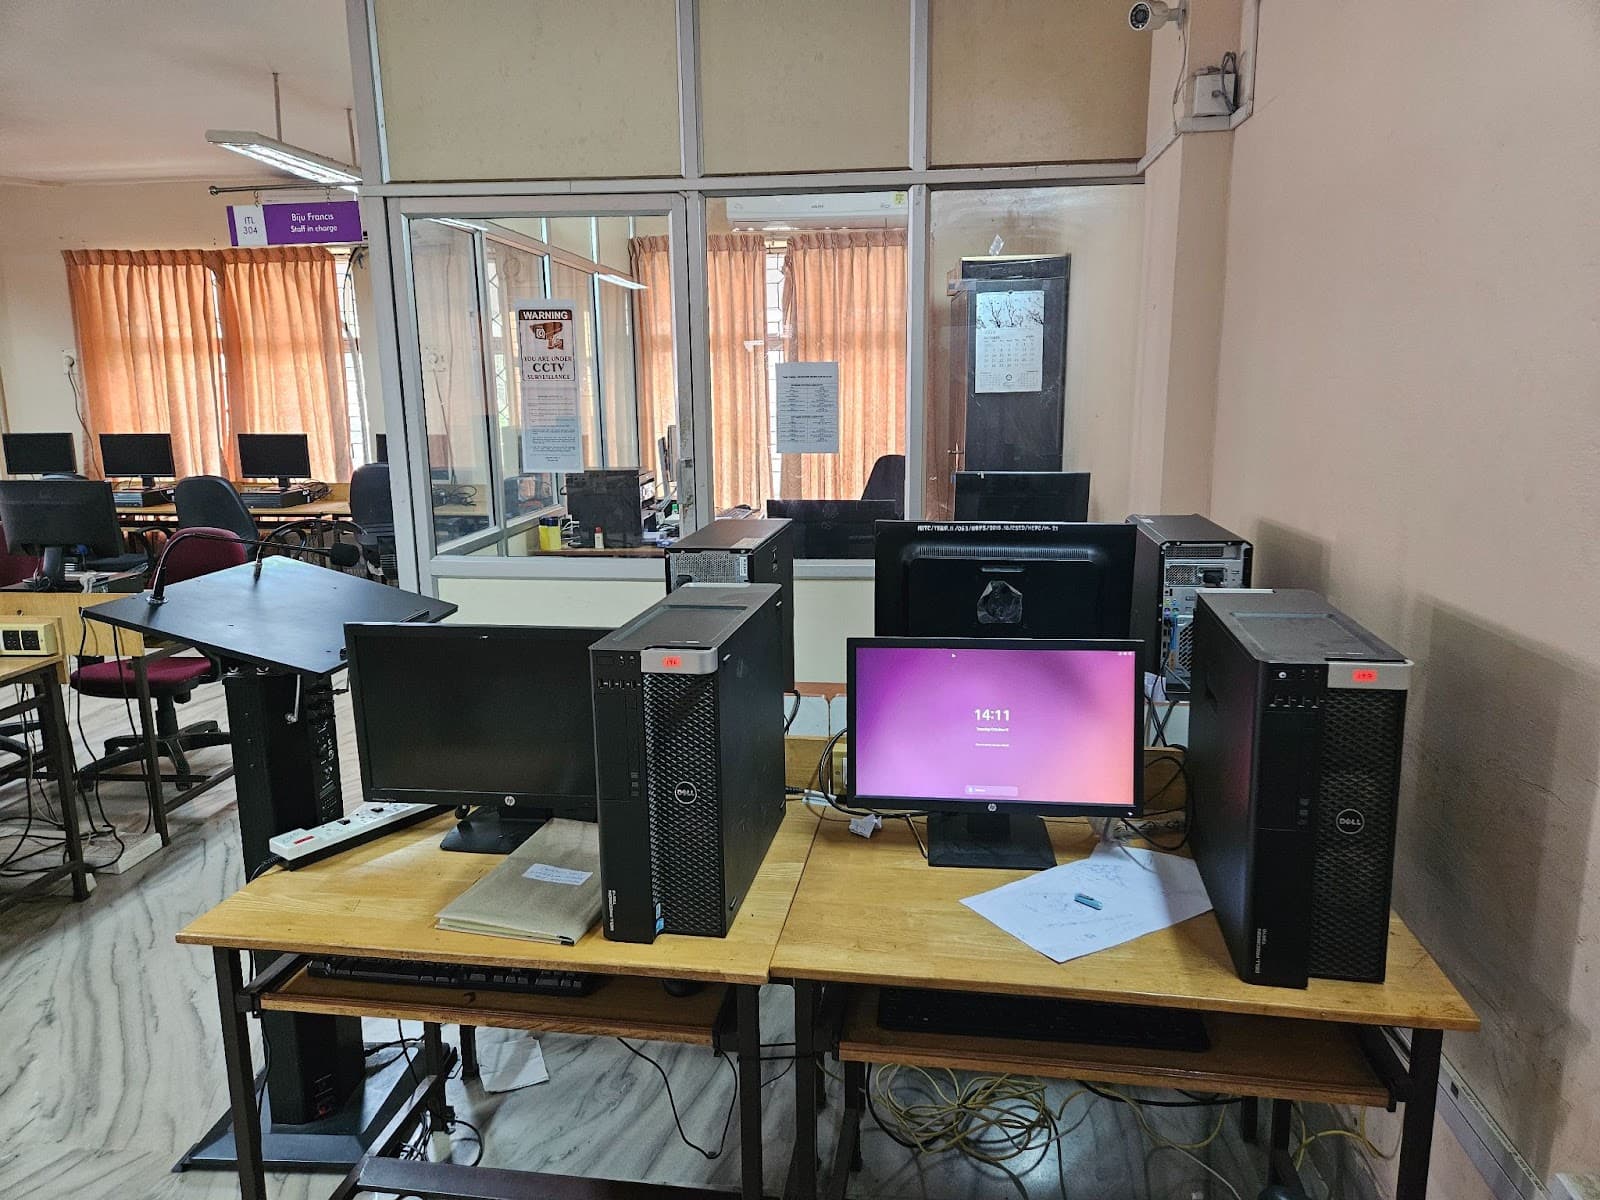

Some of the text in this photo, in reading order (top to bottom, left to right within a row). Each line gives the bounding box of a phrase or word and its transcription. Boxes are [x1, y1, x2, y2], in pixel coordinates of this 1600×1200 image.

[291, 212, 334, 223] Biju Francis
[243, 226, 258, 235] 304
[290, 225, 306, 233] Staff
[315, 224, 338, 233] charge
[523, 311, 569, 320] WARNING
[532, 363, 565, 372] CCTV
[974, 708, 1010, 721] 14:11
[677, 788, 694, 797] DELL
[1339, 817, 1361, 826] DELL
